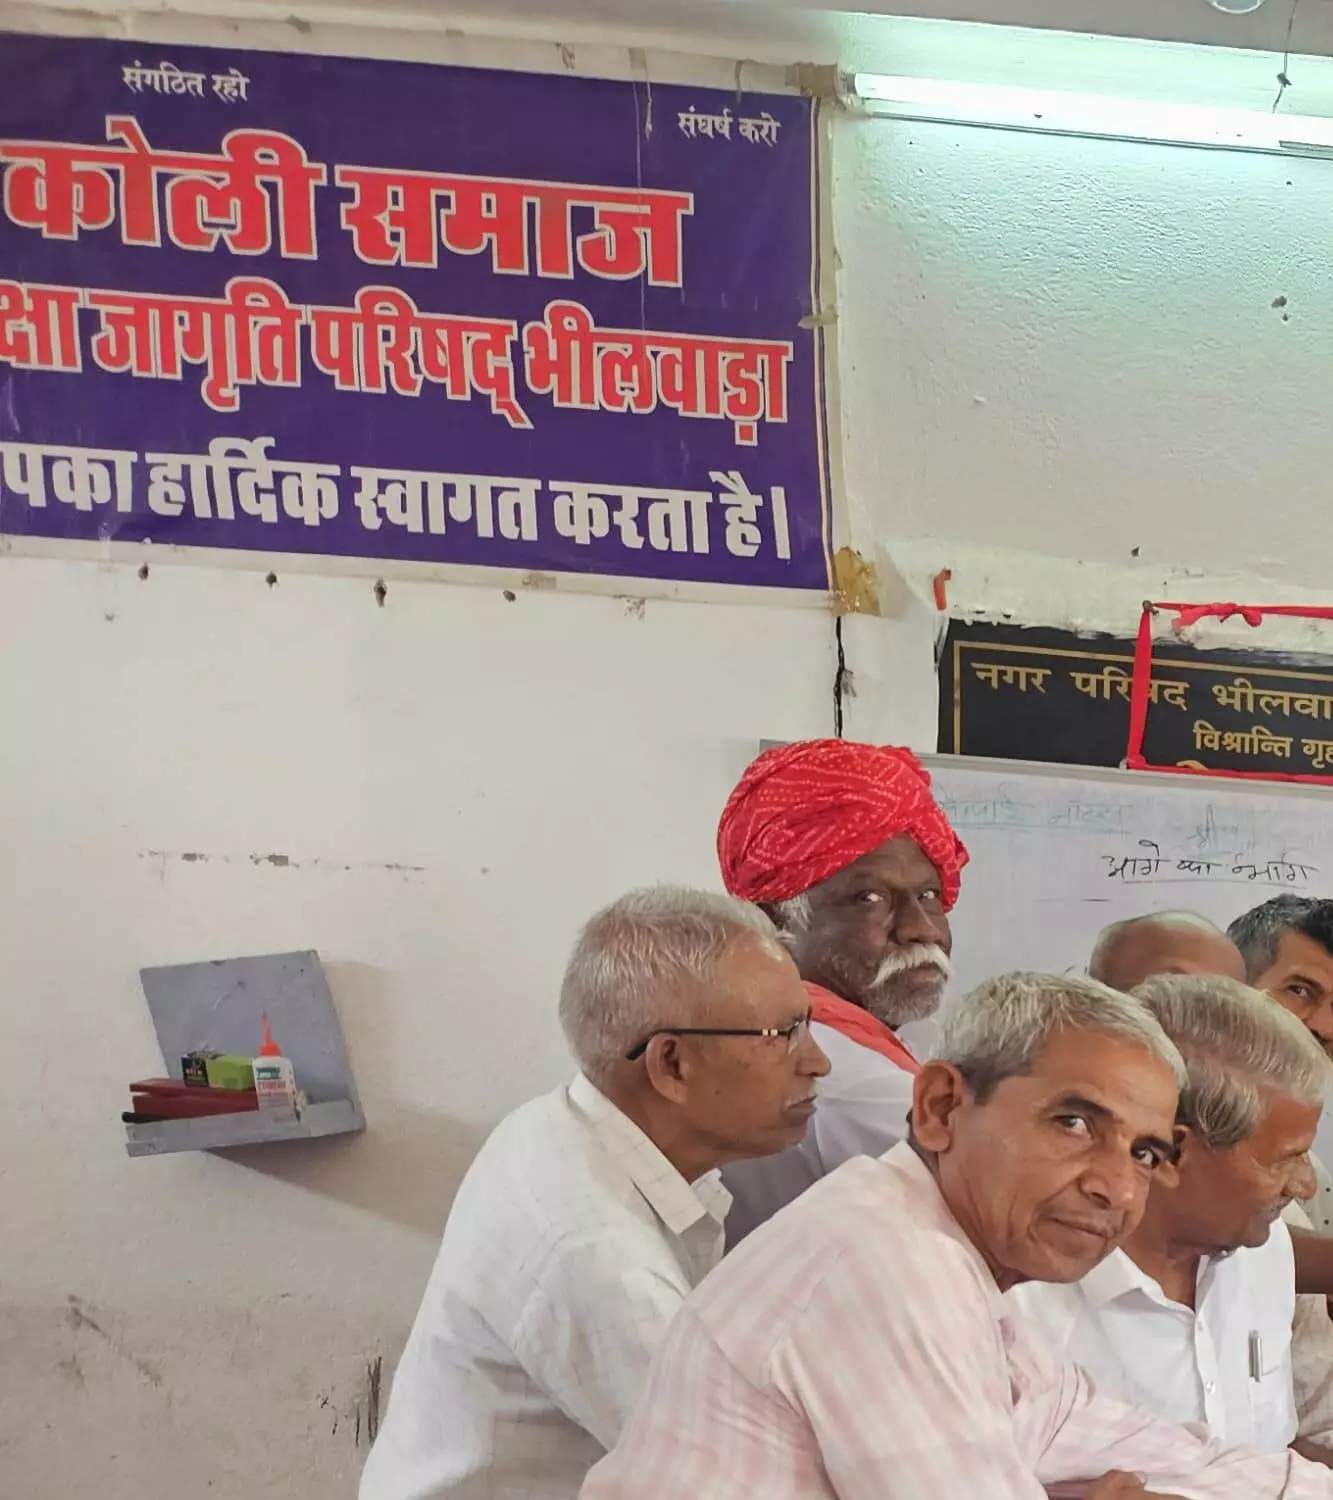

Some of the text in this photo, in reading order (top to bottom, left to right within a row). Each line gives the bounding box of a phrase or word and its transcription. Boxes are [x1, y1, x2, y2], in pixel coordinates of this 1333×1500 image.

[122, 59, 250, 104] संगठित रहो
[678, 105, 781, 147] संघर्ष करो
[0, 114, 694, 288] कोली समाज
[0, 276, 794, 446] क्षा जागृति परिषद् भीलवाड़ा
[0, 440, 138, 513] पका
[146, 436, 342, 526] हार्दिक
[350, 465, 541, 542] स्वागत
[548, 479, 713, 554] करता
[970, 661, 1052, 694] नगर
